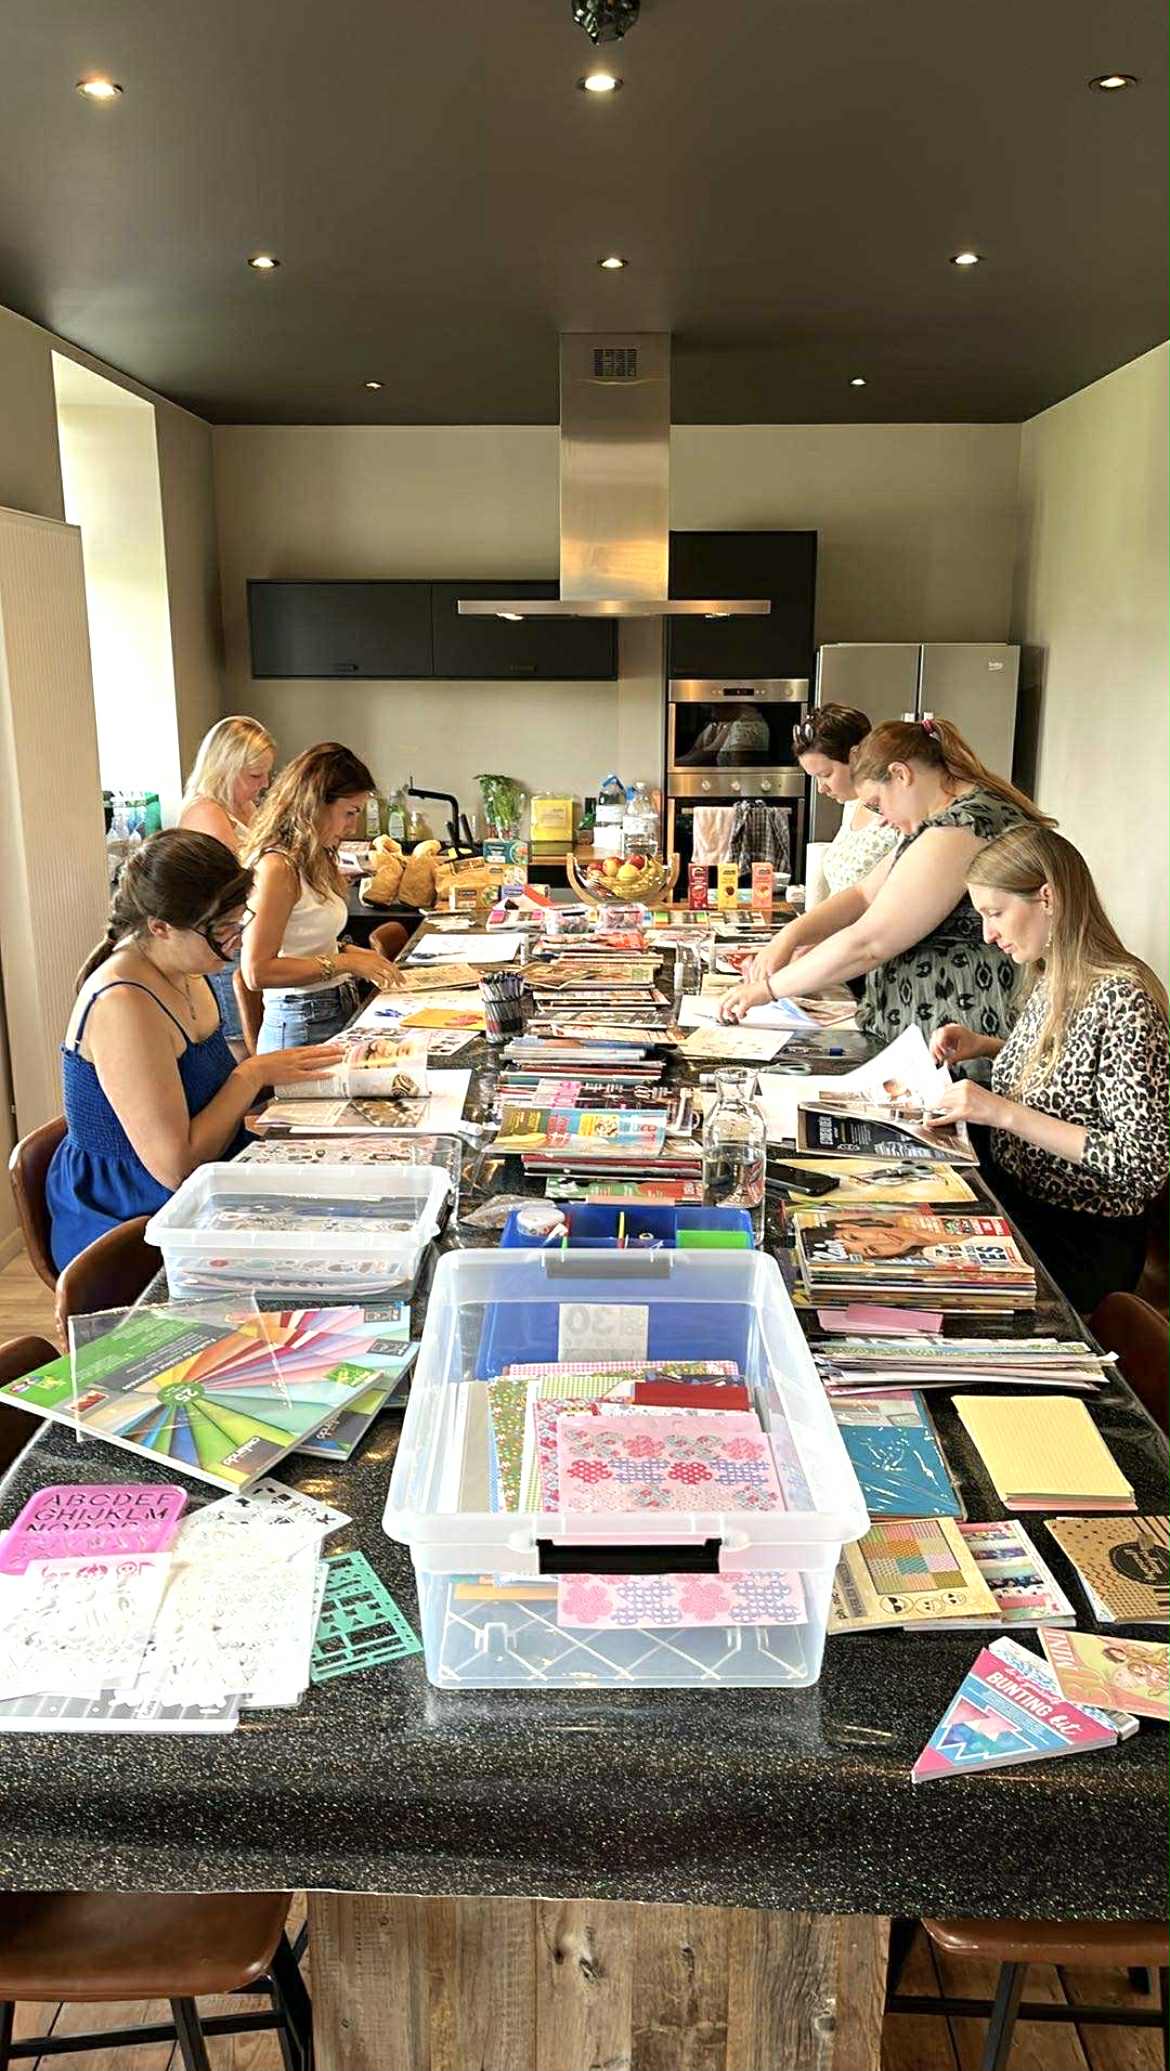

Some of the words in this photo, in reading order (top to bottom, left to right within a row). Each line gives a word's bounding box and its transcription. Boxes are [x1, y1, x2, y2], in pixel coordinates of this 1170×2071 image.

[44, 1493, 180, 1506] ABCDEF
[34, 1507, 170, 1521] GHIJKLM
[986, 1671, 1053, 1718] BUNTING
[1049, 1713, 1082, 1737] kit
